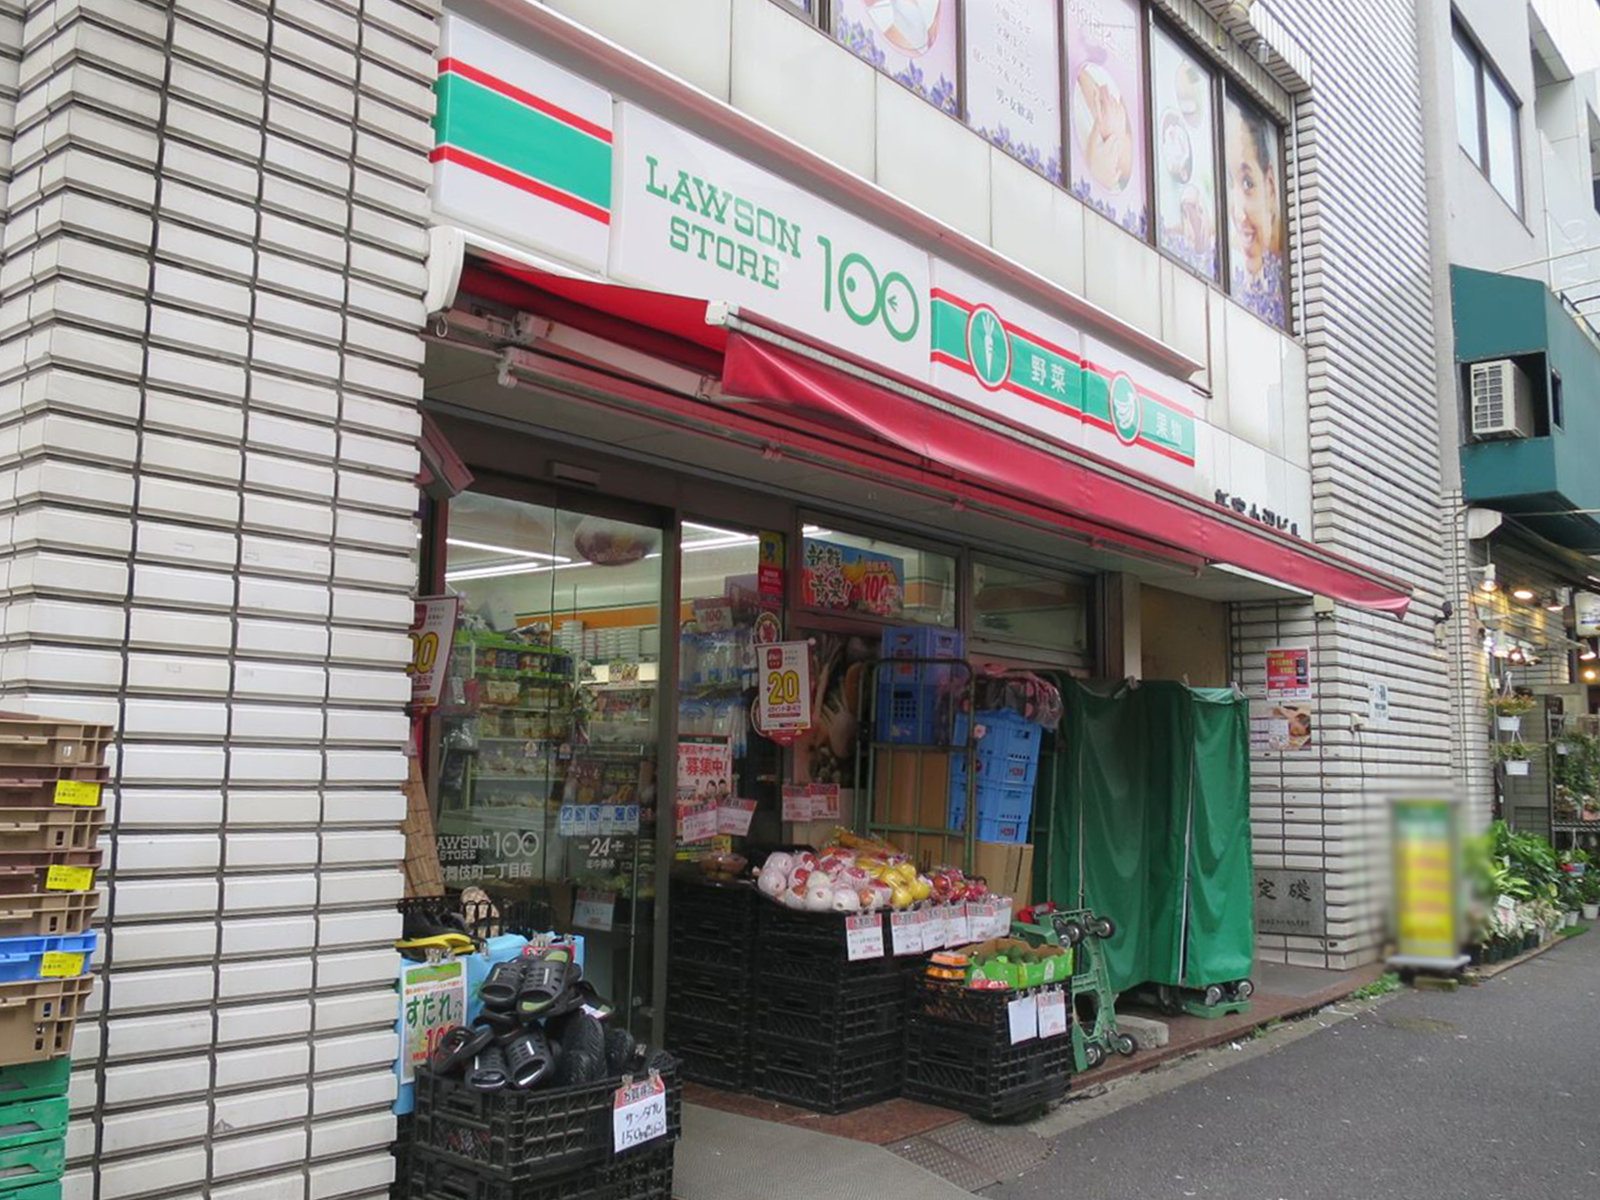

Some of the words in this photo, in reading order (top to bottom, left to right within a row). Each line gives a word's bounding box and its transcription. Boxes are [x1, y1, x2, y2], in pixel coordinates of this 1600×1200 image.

[646, 155, 802, 258] LAWSON
[669, 217, 780, 290] STORE
[817, 235, 920, 343] 100
[1031, 353, 1067, 394] 野菜
[437, 833, 491, 850] AWSON
[493, 831, 540, 858] 100
[1258, 878, 1312, 903] 定礎
[406, 993, 452, 1029] すだれ
